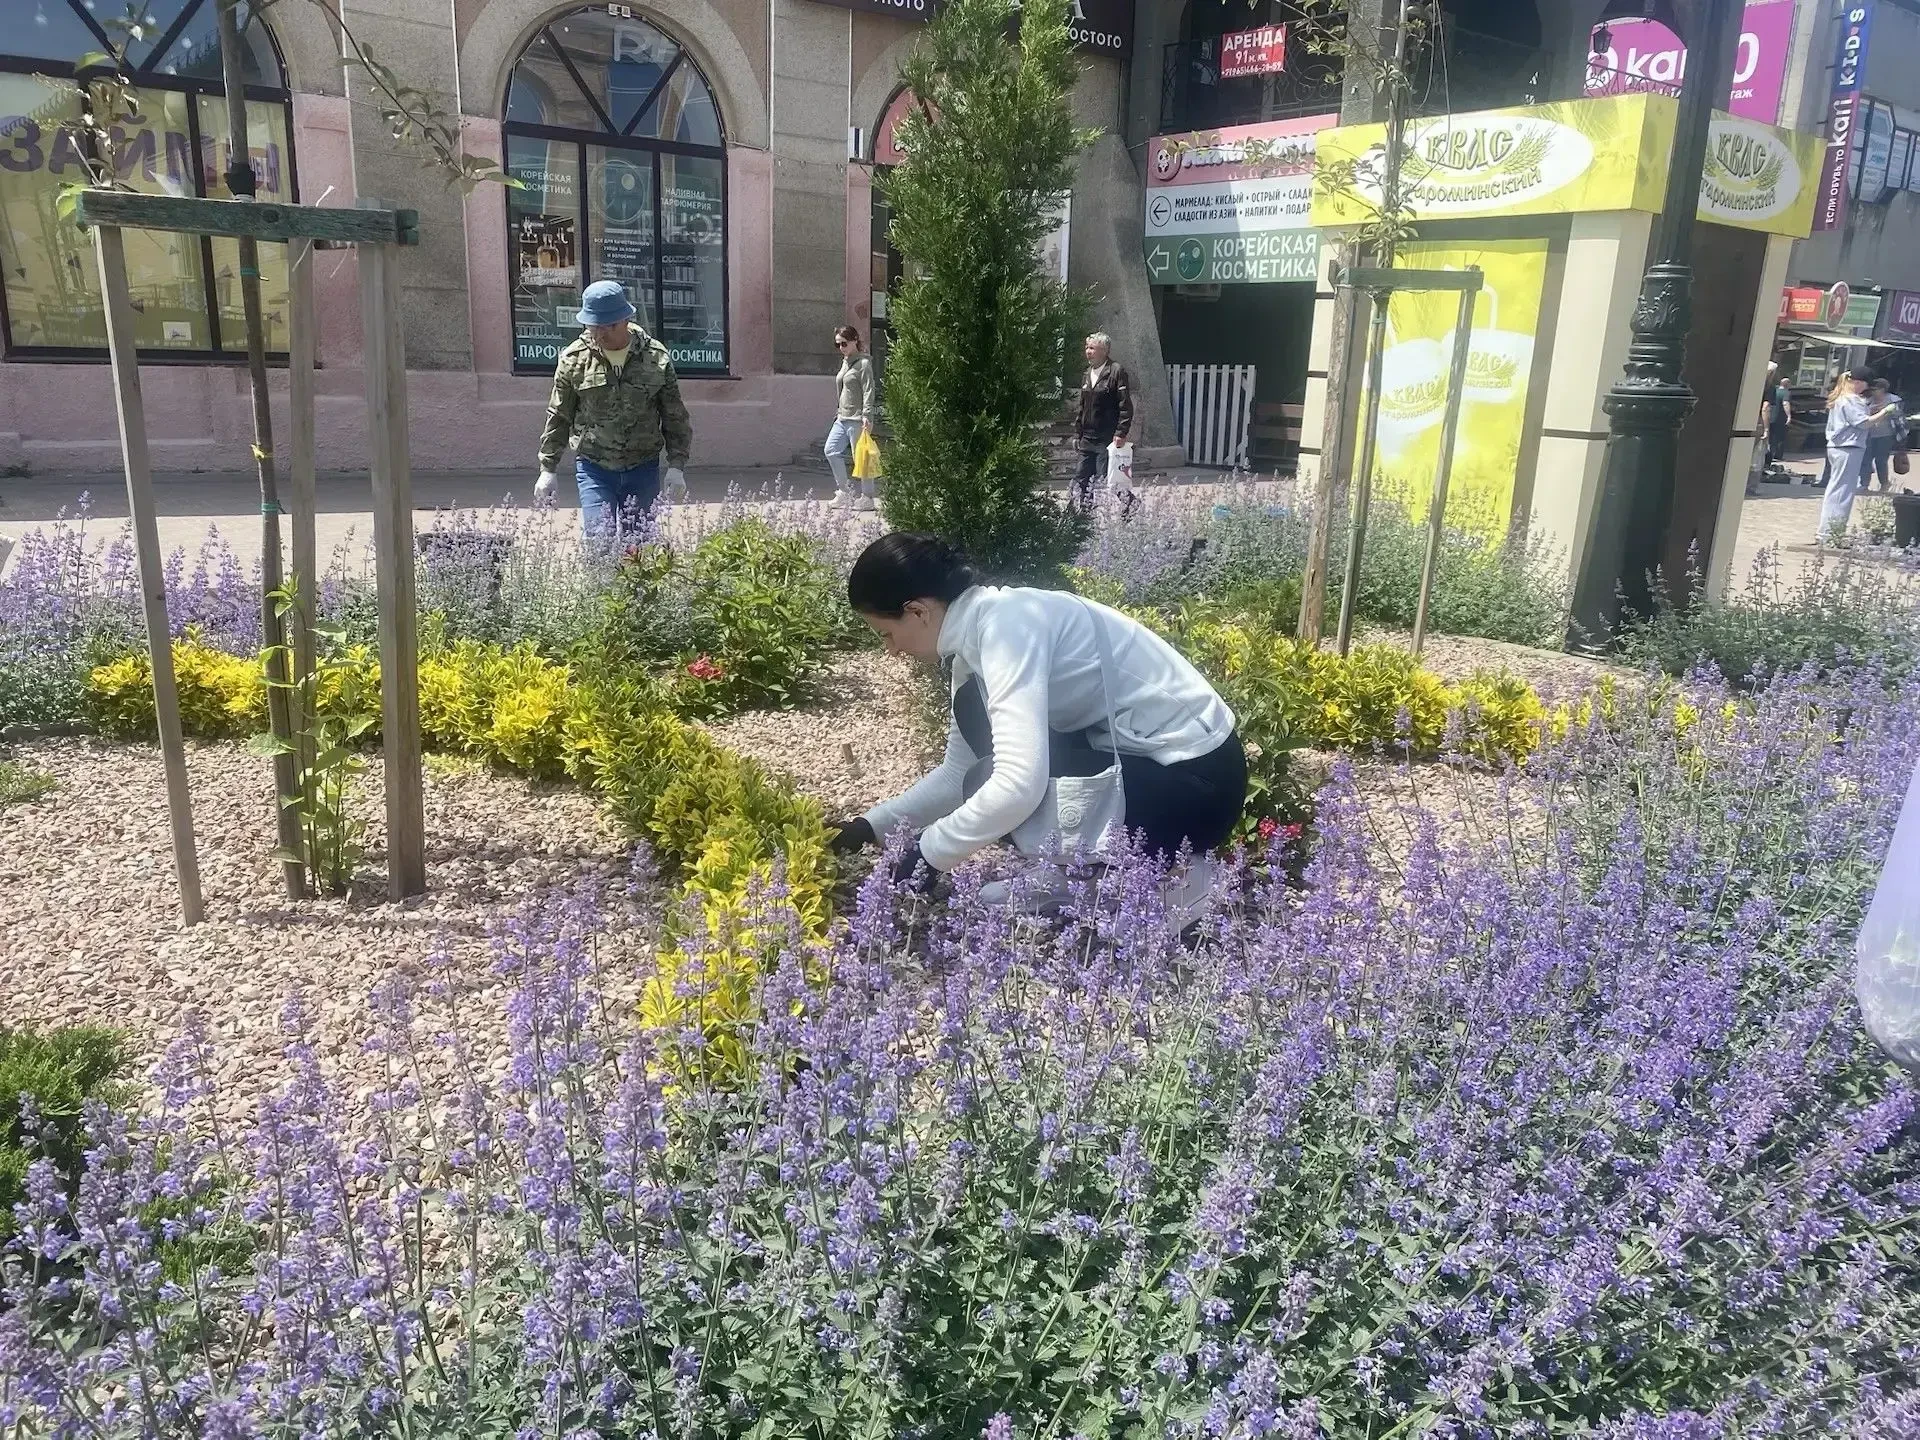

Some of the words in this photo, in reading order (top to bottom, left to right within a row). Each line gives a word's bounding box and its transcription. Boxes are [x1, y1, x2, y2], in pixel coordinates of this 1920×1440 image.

[1069, 27, 1122, 49] остого
[1224, 28, 1283, 51] АРЕНДА
[1235, 50, 1248, 65] 91
[1730, 88, 1753, 100] таж
[1835, 149, 1844, 163] ТО
[520, 169, 572, 183] КОРЕЙСКАЯ
[1401, 167, 1542, 207] тароминский
[1830, 164, 1843, 197] ОБУВЬ,
[1175, 197, 1214, 208] МАРМЕЛАД:
[1215, 193, 1244, 206] КИСЛЫЙ
[1251, 189, 1281, 203] ОСТРЫЙ
[1174, 209, 1207, 222] СЛАДОСТИ
[1208, 208, 1218, 220] ИЗ
[1218, 206, 1237, 219] АЗИИ
[1244, 204, 1278, 218] НАПИТКИ
[1825, 198, 1837, 224] ЕСЛИ
[1212, 232, 1319, 259] КОРЕЙСКАЯ
[1211, 256, 1318, 280] КОСМЕТИКА
